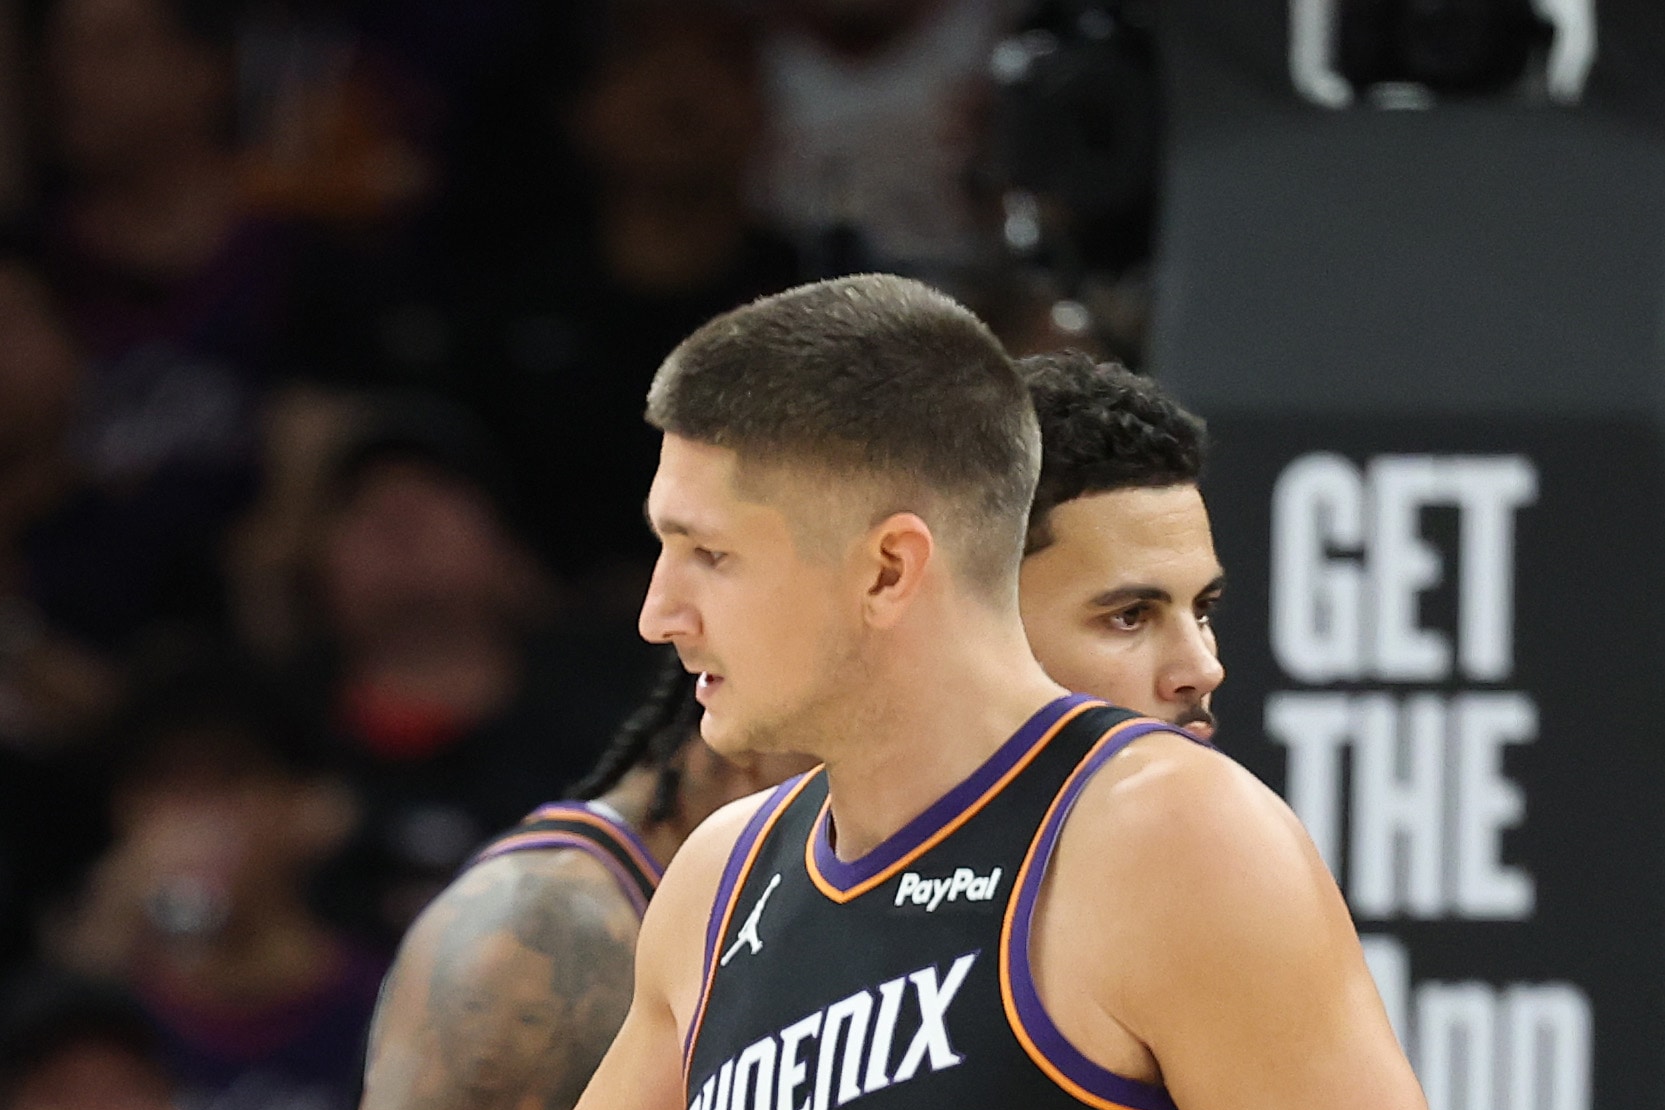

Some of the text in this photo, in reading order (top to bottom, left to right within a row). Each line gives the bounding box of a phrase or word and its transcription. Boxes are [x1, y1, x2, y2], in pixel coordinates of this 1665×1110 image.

[1270, 452, 1539, 683] GET
[895, 868, 1002, 912] PayPal
[1264, 690, 1539, 921] THE
